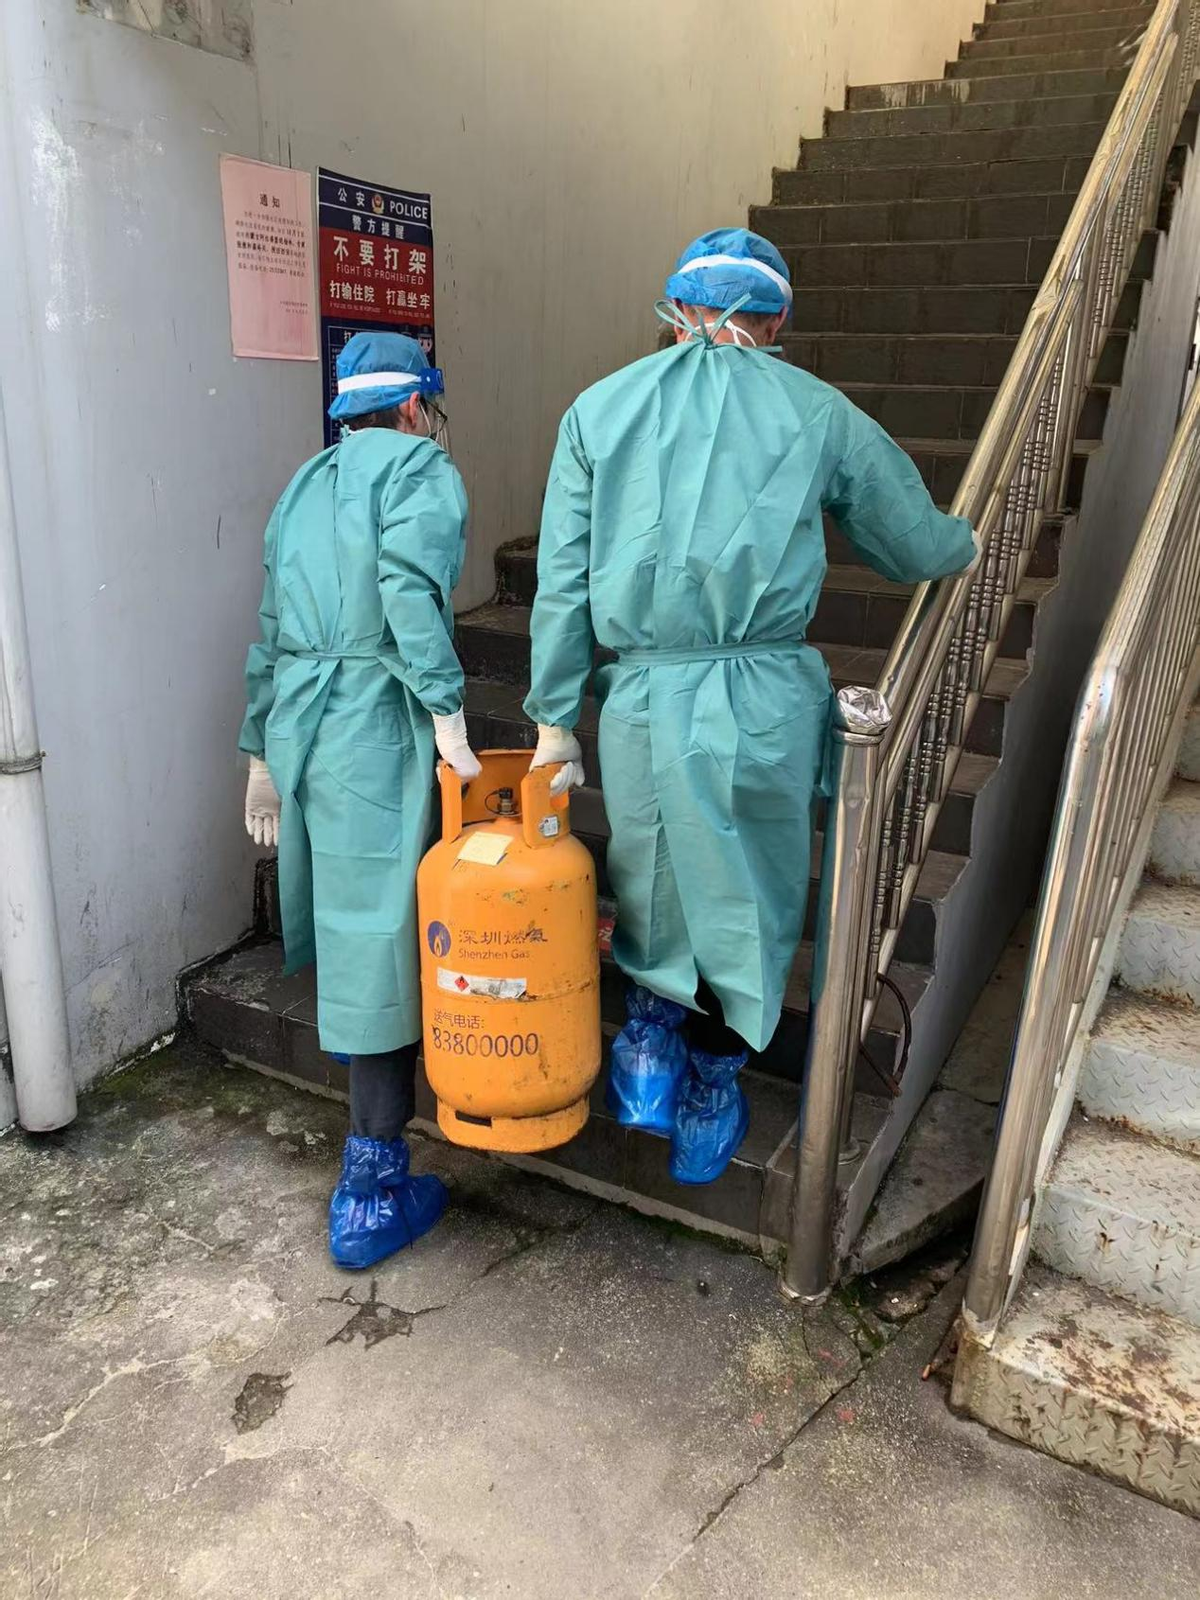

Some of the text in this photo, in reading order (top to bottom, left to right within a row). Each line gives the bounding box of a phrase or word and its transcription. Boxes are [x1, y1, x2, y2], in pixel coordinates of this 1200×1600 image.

[259, 193, 280, 208] 通知
[337, 187, 365, 207] 公安
[389, 200, 428, 220] POLICE
[352, 214, 404, 239] 警方提醒
[333, 235, 427, 275] 不要打架
[336, 262, 424, 285] FIGHT IS PROHIBITED
[329, 280, 375, 302] 打输住院
[386, 288, 431, 310] 打赢坐牢
[459, 949, 530, 960] Shenzhen Gas
[432, 1025, 539, 1058] 83800000
